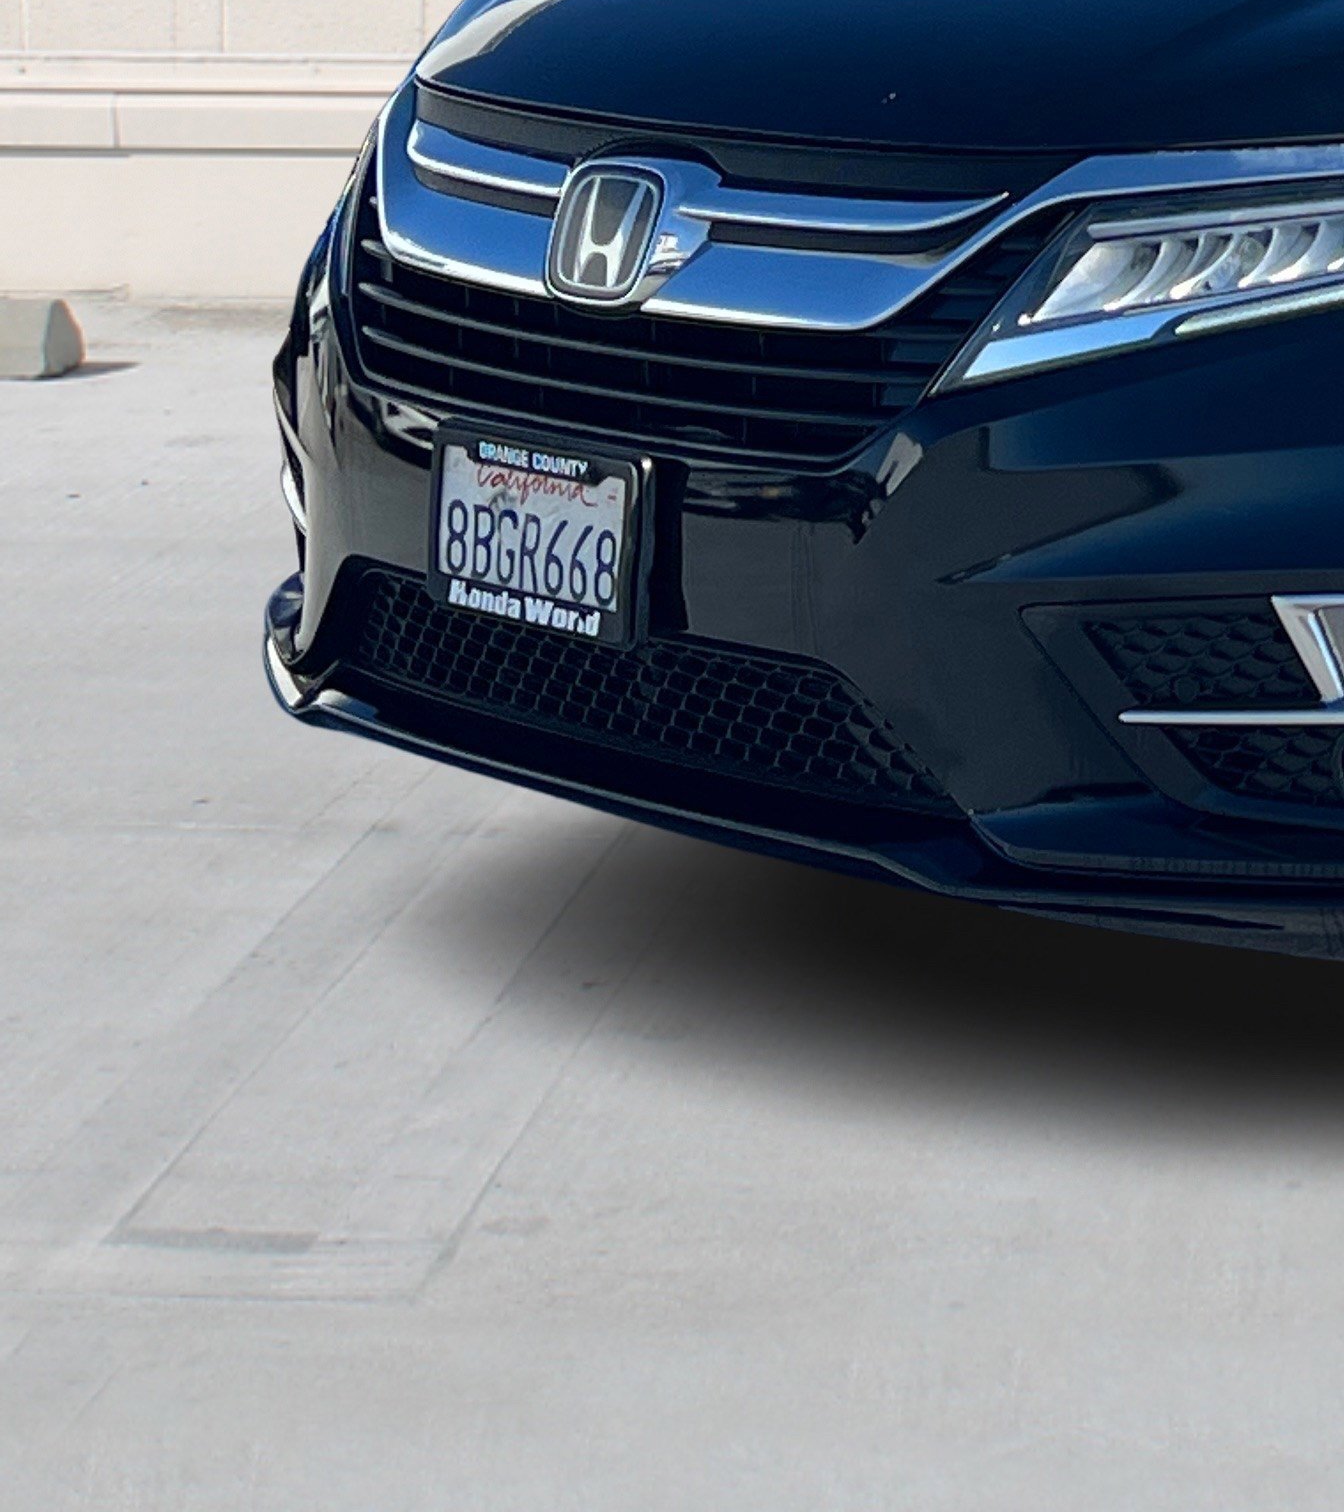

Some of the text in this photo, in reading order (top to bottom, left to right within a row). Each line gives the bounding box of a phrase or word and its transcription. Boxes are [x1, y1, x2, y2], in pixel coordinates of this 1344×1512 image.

[532, 451, 589, 478] COUNTY
[445, 498, 617, 607] 8BGR668
[448, 578, 601, 638] Honda World
